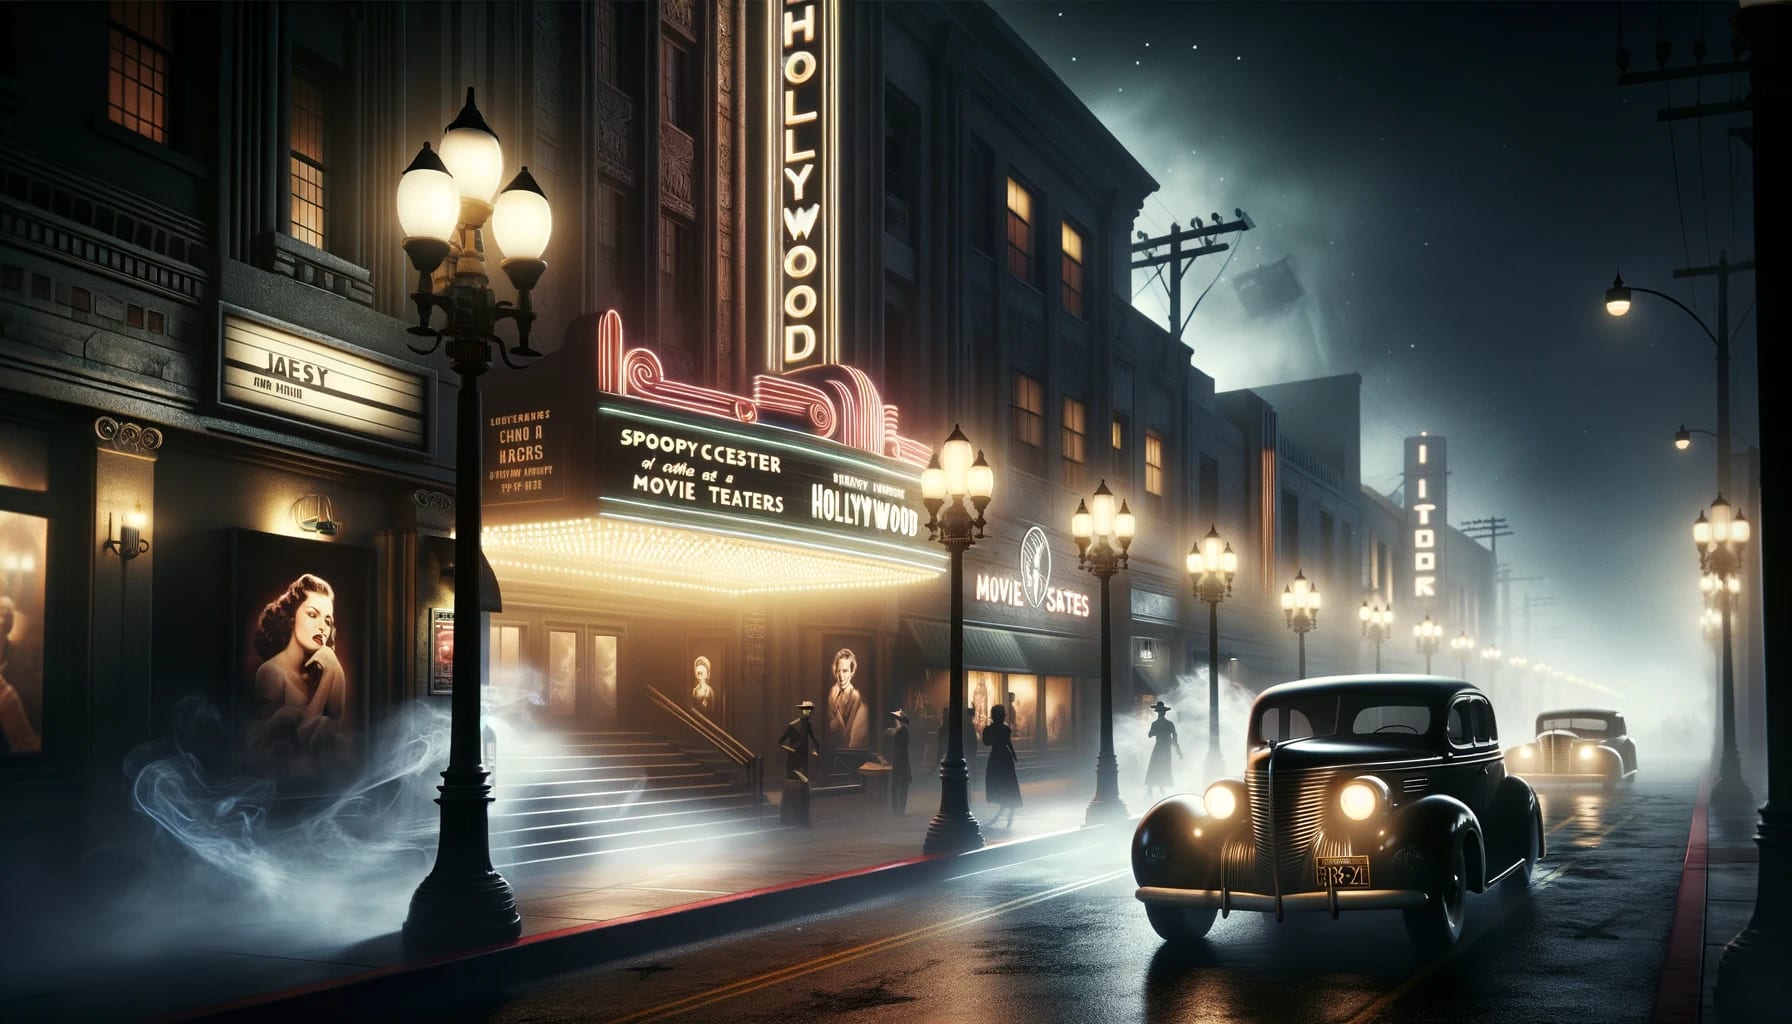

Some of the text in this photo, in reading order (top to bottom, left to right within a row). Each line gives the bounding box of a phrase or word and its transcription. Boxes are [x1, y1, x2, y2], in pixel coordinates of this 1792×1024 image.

[783, 5, 820, 364] HOLLYWOOD
[620, 429, 698, 457] SPOOPY
[633, 474, 784, 513] MOVIE TEATERS
[976, 574, 1090, 618] MOVIE SATES
